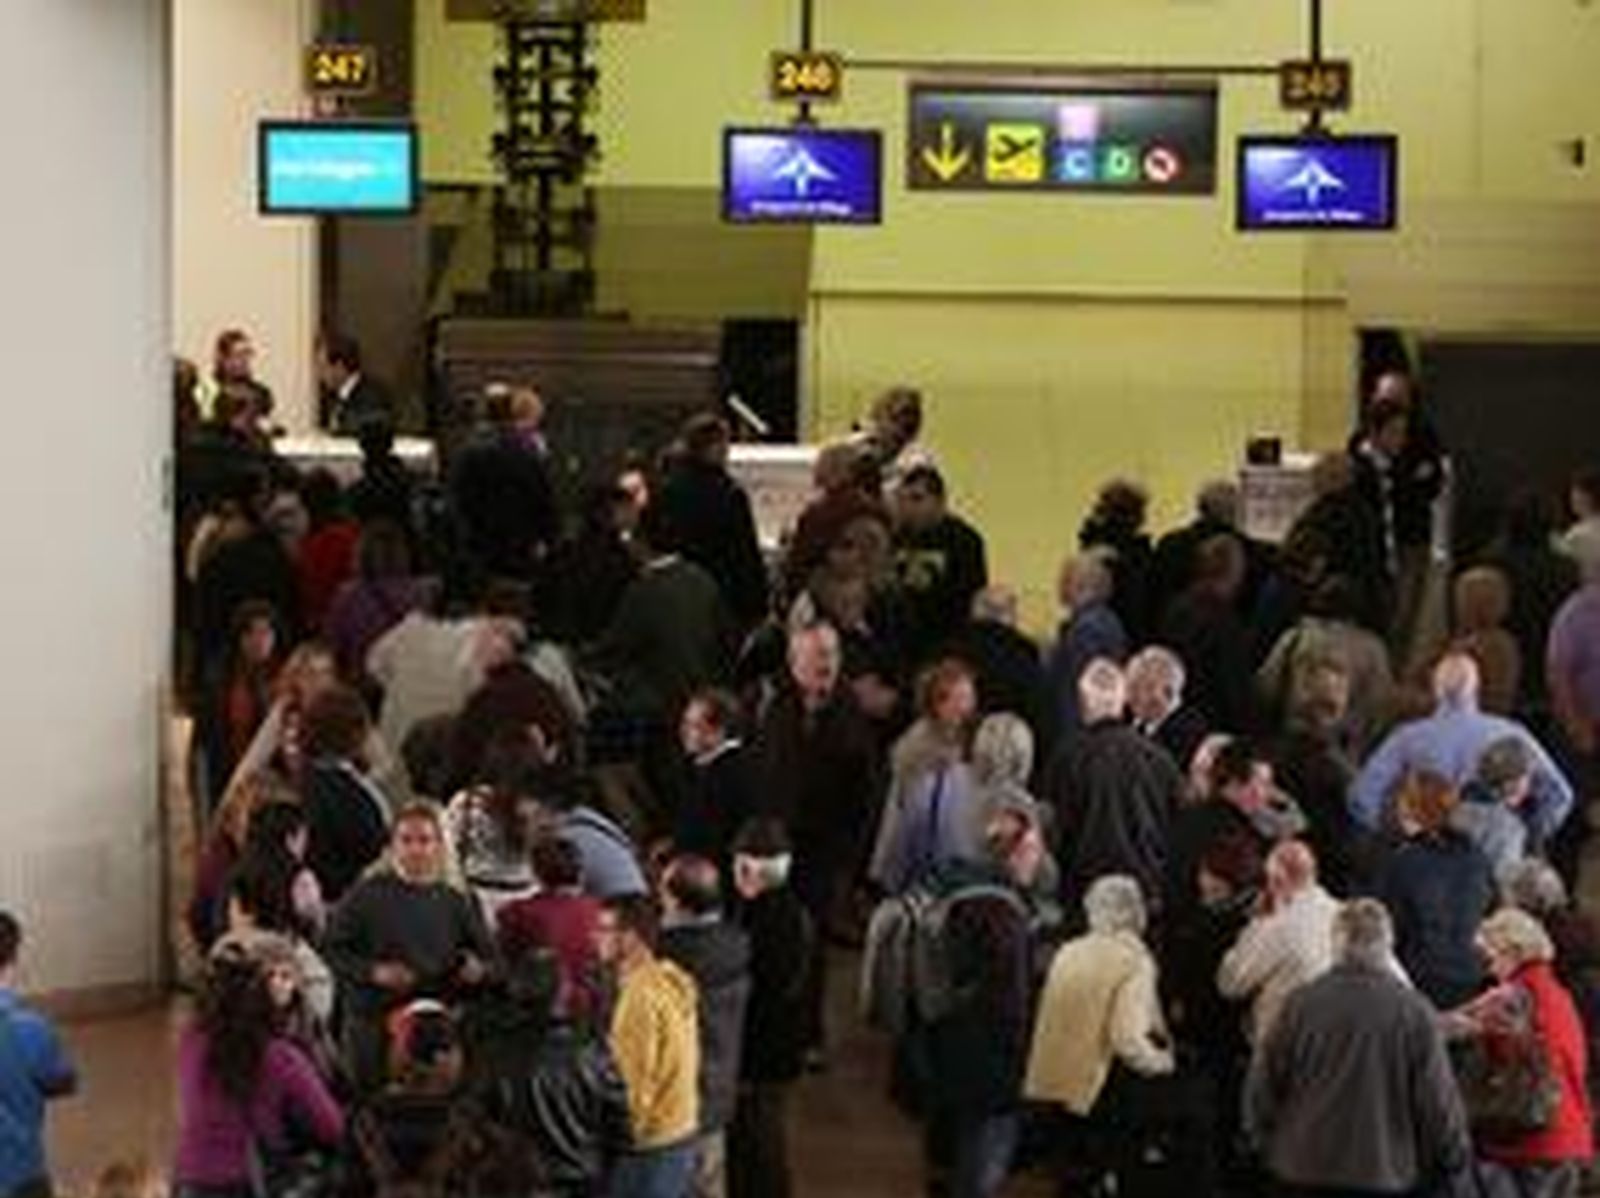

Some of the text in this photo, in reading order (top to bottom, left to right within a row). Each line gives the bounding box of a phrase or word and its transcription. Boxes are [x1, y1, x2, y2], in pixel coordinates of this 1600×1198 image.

[312, 51, 364, 82] 247
[1064, 146, 1131, 176] C D
